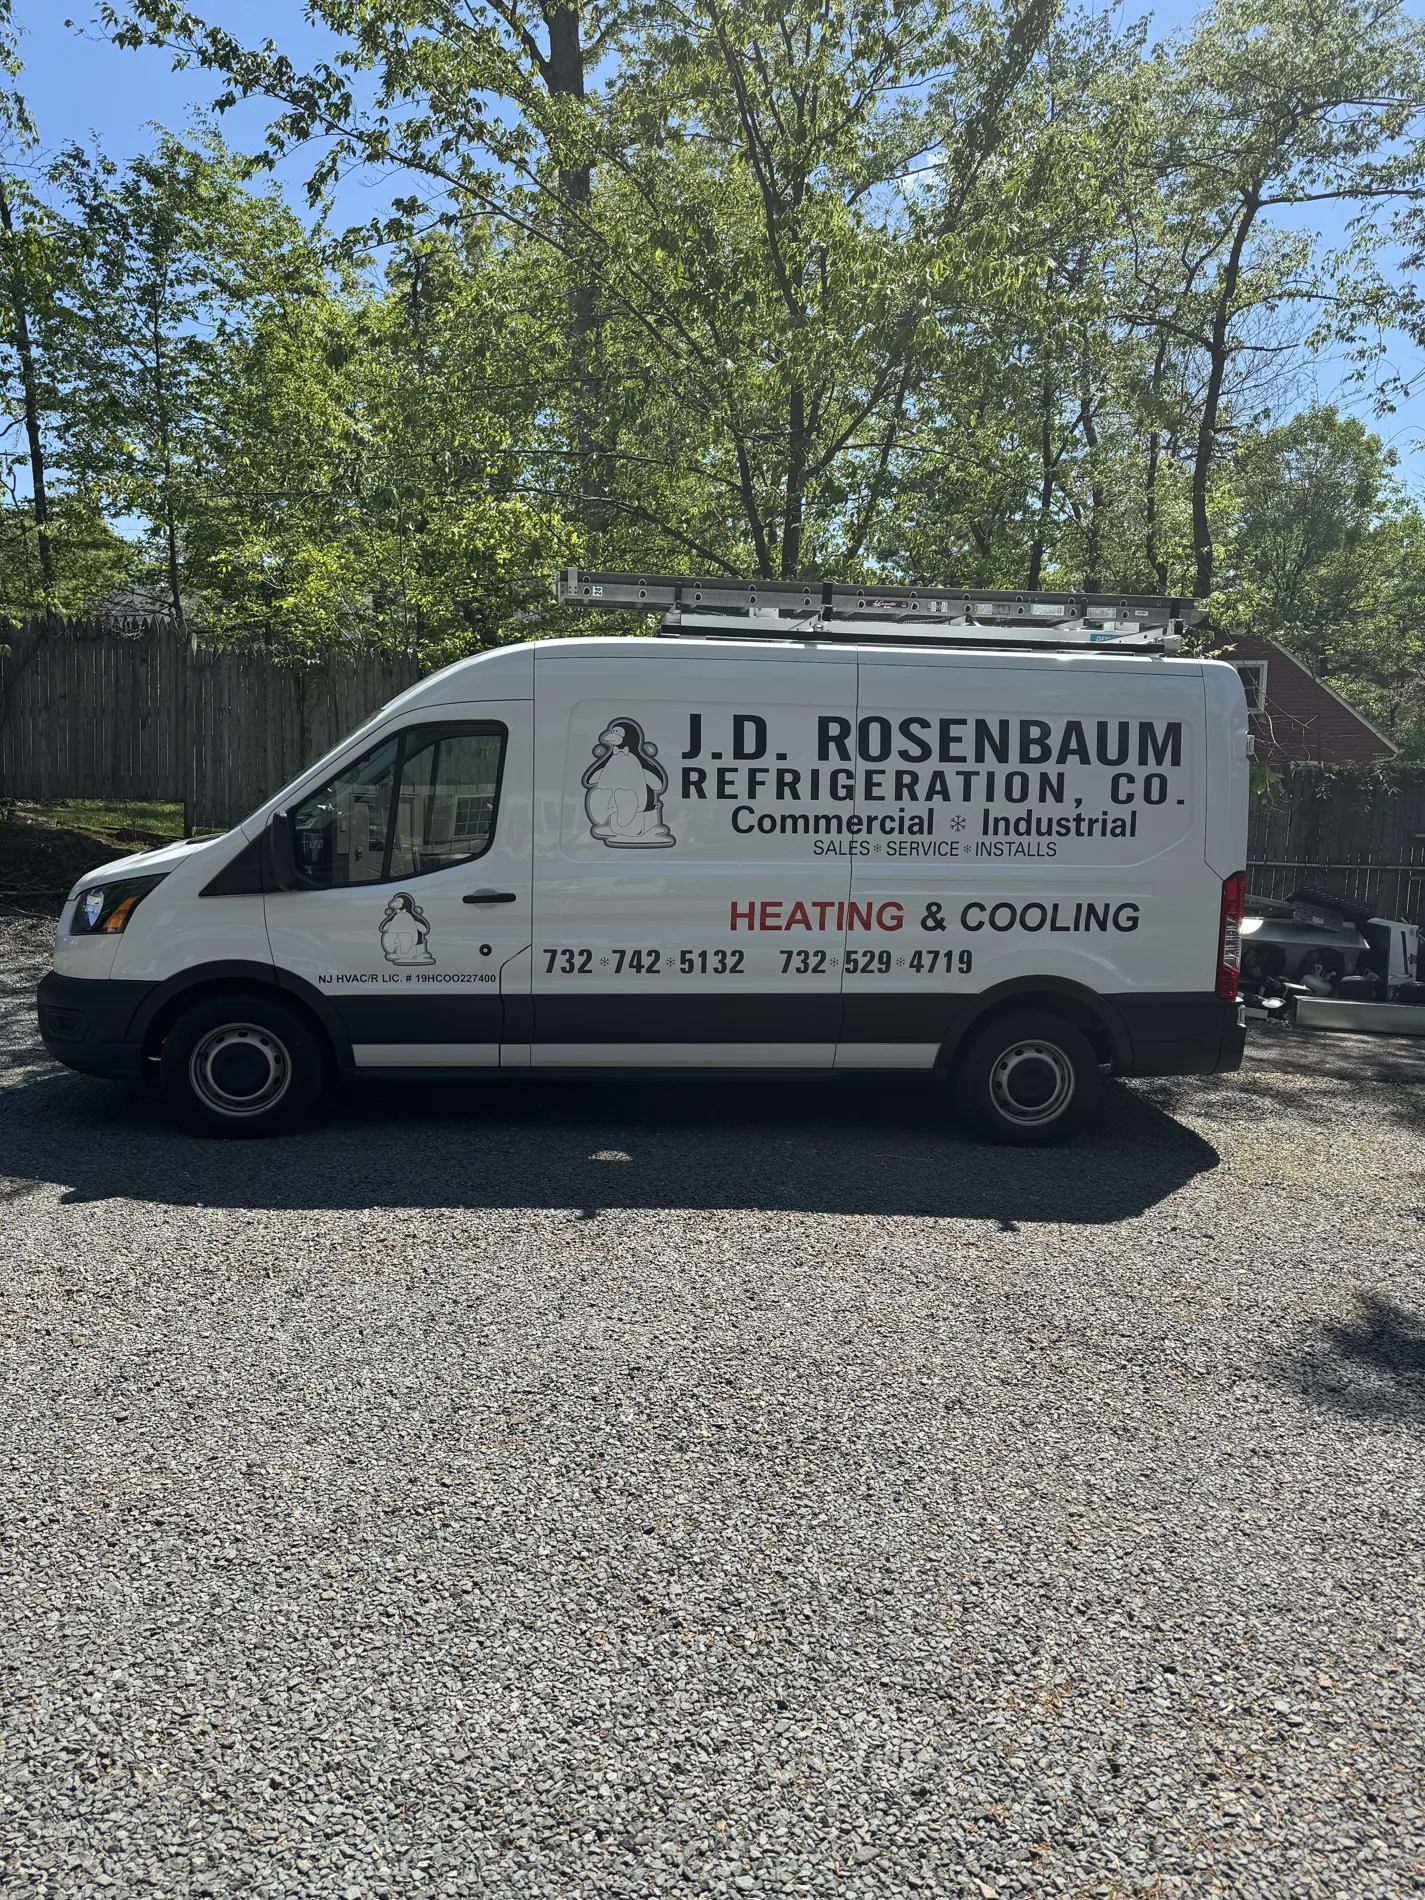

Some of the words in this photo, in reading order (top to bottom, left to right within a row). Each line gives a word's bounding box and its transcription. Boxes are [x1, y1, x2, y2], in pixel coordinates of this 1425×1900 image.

[682, 714, 787, 761] J.D.
[818, 715, 1181, 767] ROSENBAUM
[682, 767, 1083, 810] REFRIGERATION,
[1111, 773, 1185, 806] CO.
[731, 804, 935, 836] Commercial
[982, 808, 1138, 838] Industrial
[813, 840, 870, 856] SALES
[887, 841, 960, 857] SERVICE
[975, 842, 1057, 857] INSTALLS
[731, 901, 904, 932] HEATING
[920, 902, 948, 932] &
[960, 902, 1141, 932] COOLING
[543, 949, 593, 974] 732
[611, 949, 661, 974] 742
[679, 949, 745, 975] 5132
[779, 949, 827, 975] 732
[844, 949, 892, 974] 529
[908, 949, 973, 975] 4719
[318, 974, 333, 984] NJ
[336, 974, 380, 984] HVAC/R
[381, 973, 403, 984] LIC.
[405, 973, 413, 983] #
